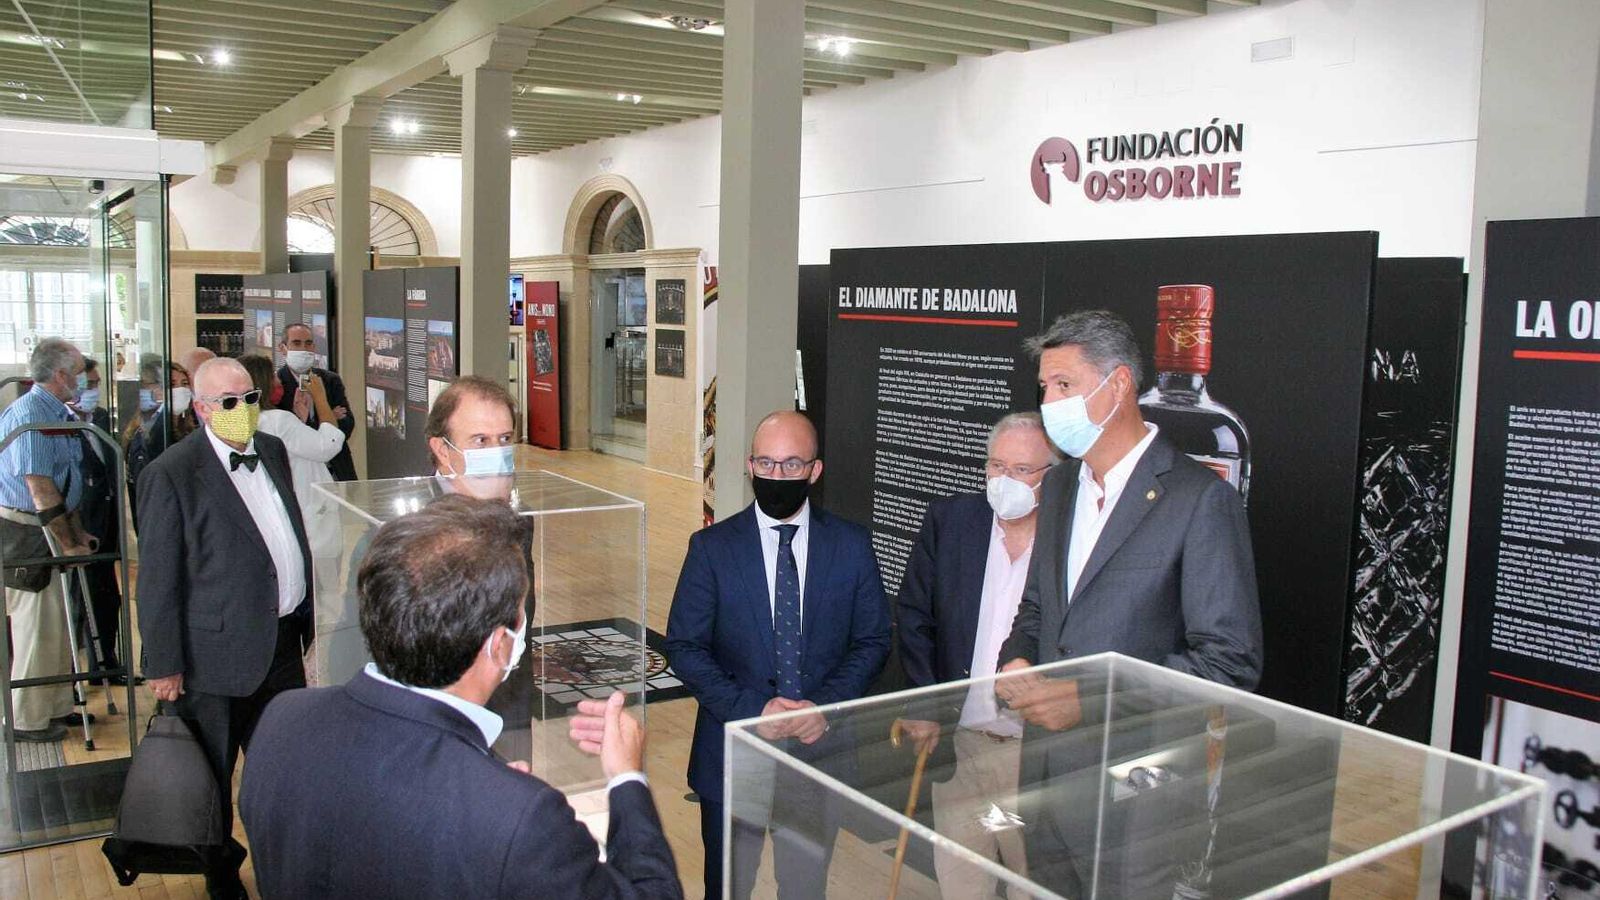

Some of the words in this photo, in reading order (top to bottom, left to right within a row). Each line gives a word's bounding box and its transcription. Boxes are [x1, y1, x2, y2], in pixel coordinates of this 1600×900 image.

[1086, 118, 1244, 163] FUNDACIÓN
[1084, 162, 1242, 202] OSBORNE
[838, 286, 852, 307] EL
[856, 287, 918, 310] DIAMANTE
[922, 288, 939, 311] DE
[944, 289, 1018, 313] BADALONA
[1515, 300, 1556, 338] LA
[1568, 300, 1600, 340] O
